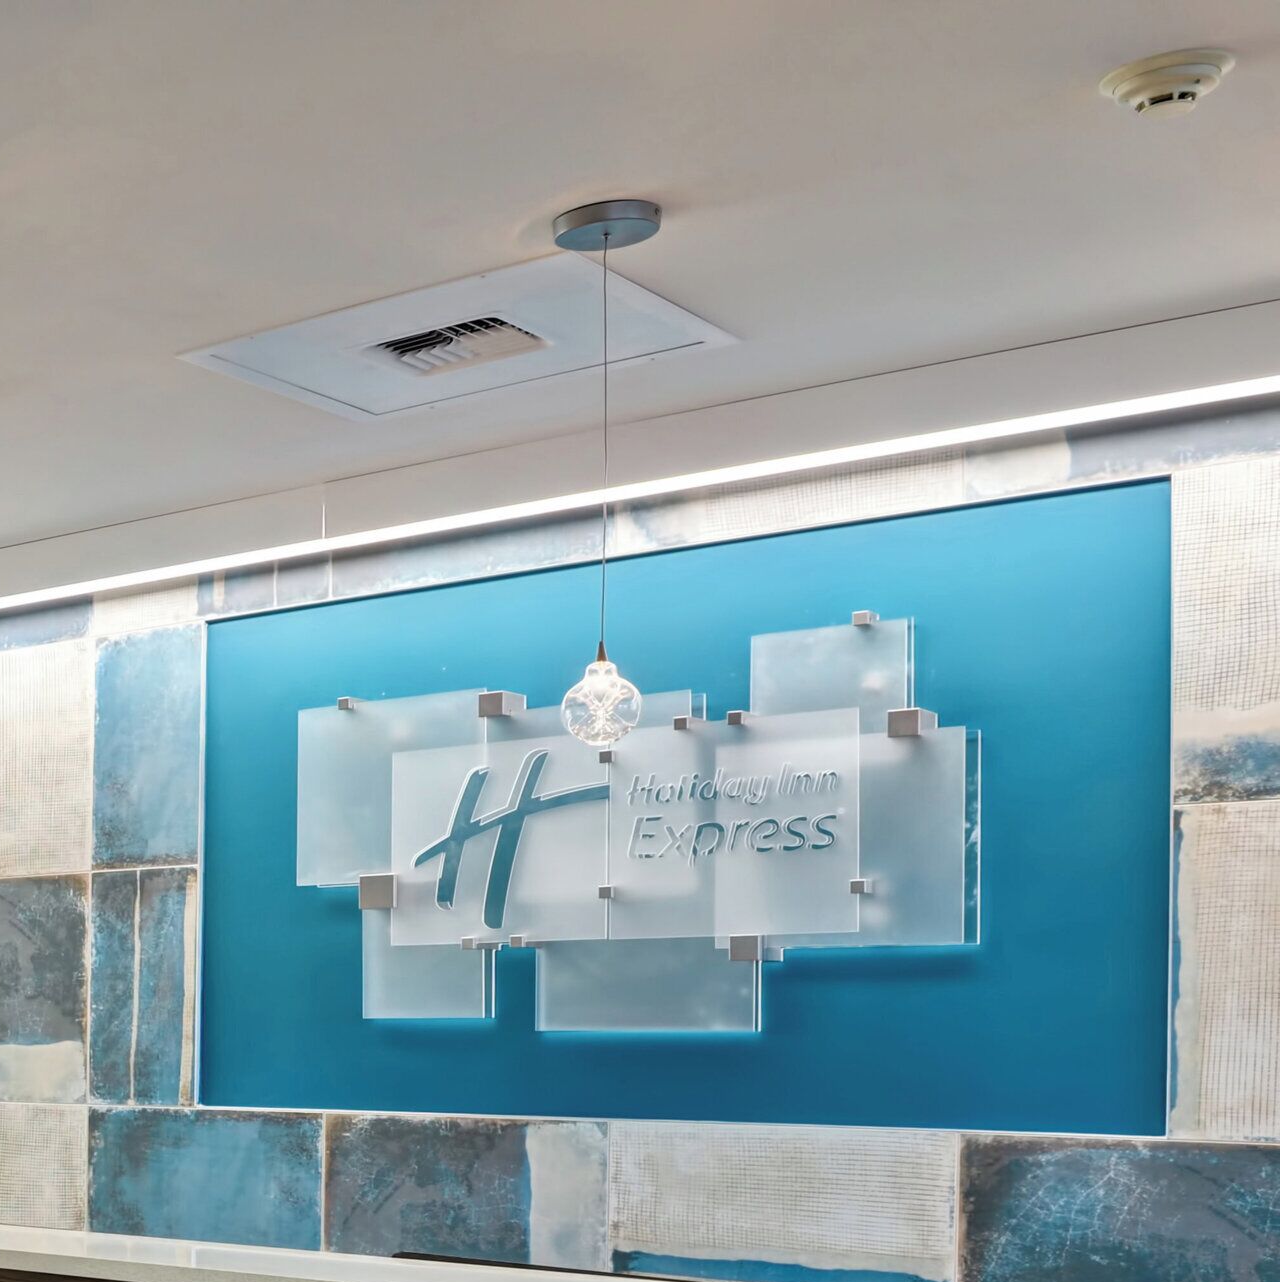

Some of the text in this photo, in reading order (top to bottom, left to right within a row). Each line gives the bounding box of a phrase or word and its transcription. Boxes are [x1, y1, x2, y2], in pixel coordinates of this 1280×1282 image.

[626, 762, 840, 806] Holiday Inn
[627, 813, 838, 868] Express
